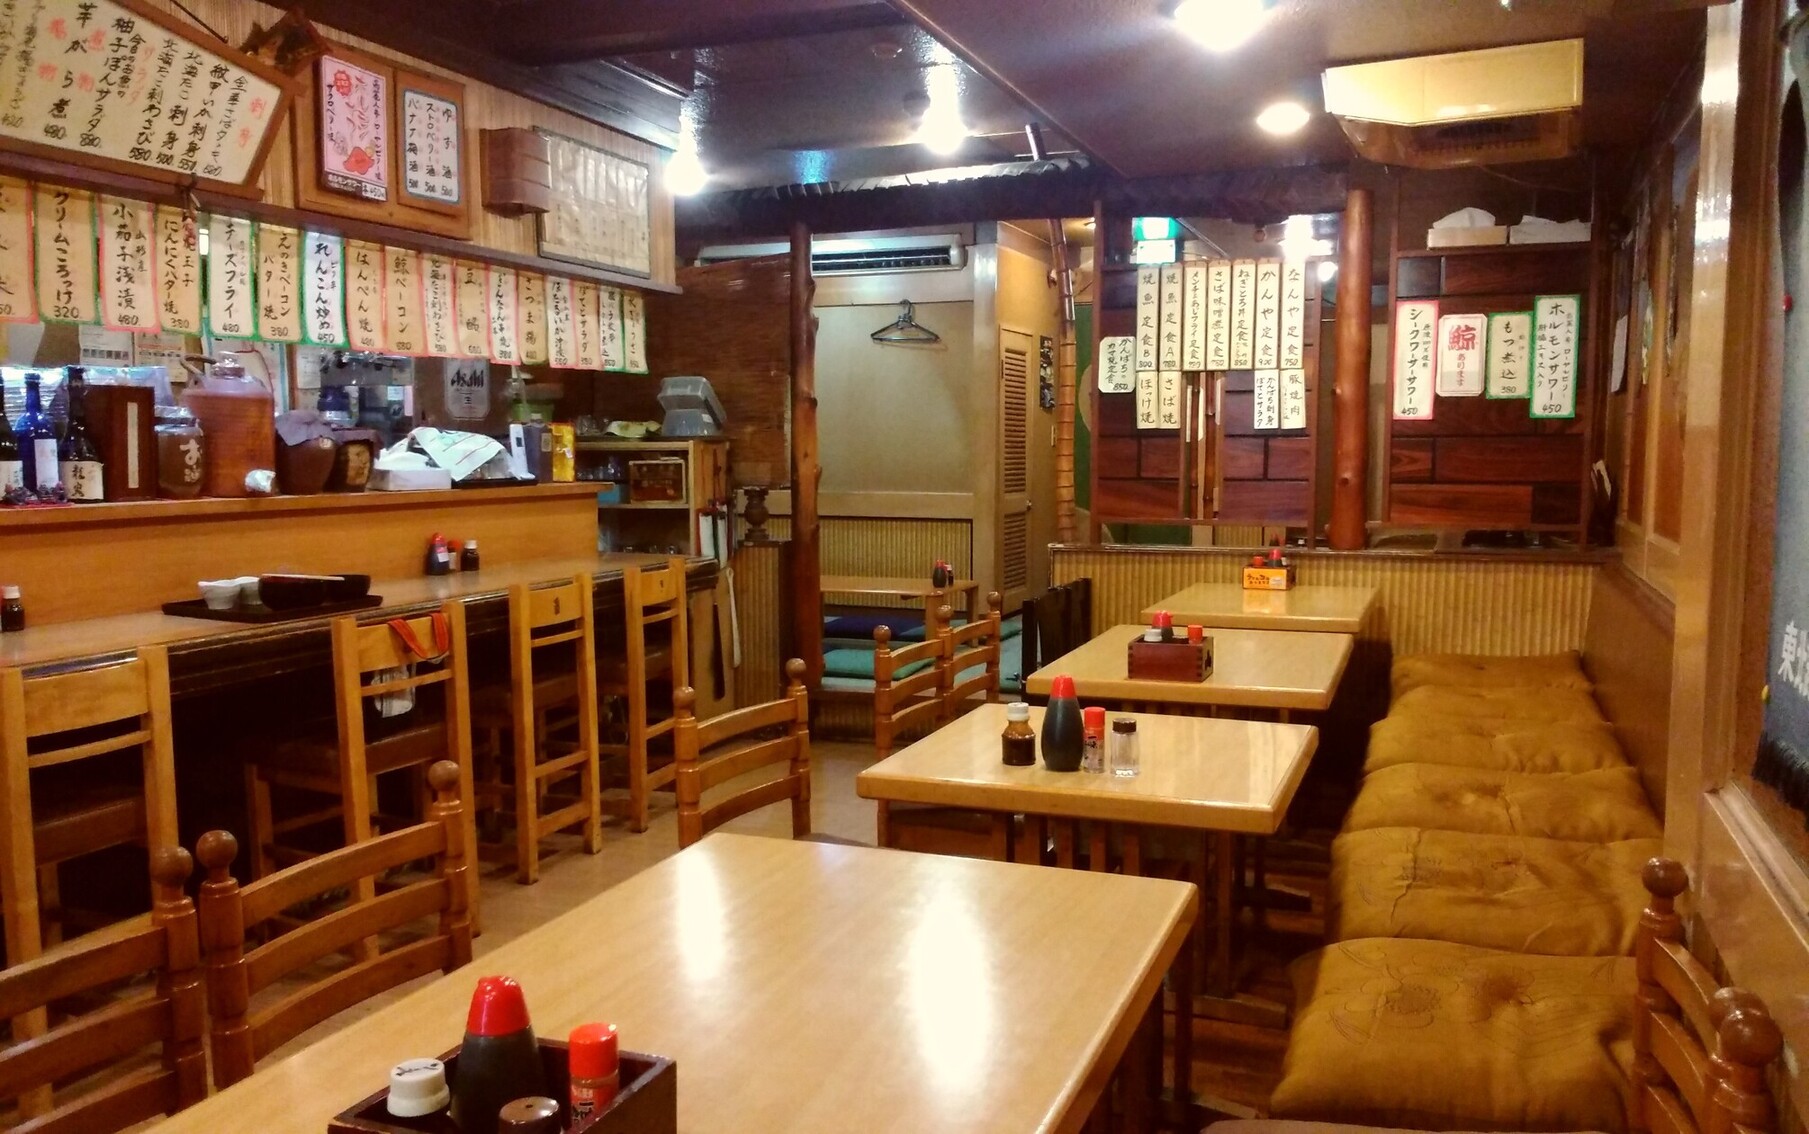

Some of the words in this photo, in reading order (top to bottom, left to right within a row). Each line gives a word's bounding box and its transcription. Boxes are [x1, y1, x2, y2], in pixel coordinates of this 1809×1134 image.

[53, 192, 74, 304] クリームころっけ
[263, 255, 278, 320] バター焼
[278, 233, 292, 316] えのきベーコン
[393, 256, 410, 333] 鯨ベーコン
[53, 306, 80, 319] 320
[118, 314, 140, 325] 480
[1211, 270, 1226, 358] さば味噌煮定食
[1448, 324, 1477, 351] 鯨
[1500, 321, 1517, 380] もつ煮込
[1549, 303, 1565, 401] ホルモンサワー
[450, 368, 484, 388] Asahi
[1501, 385, 1517, 393] 380
[1140, 379, 1155, 423] ほっけ焼
[1162, 378, 1177, 424] さば焼
[1401, 407, 1419, 415] 450
[1542, 404, 1562, 413] 450
